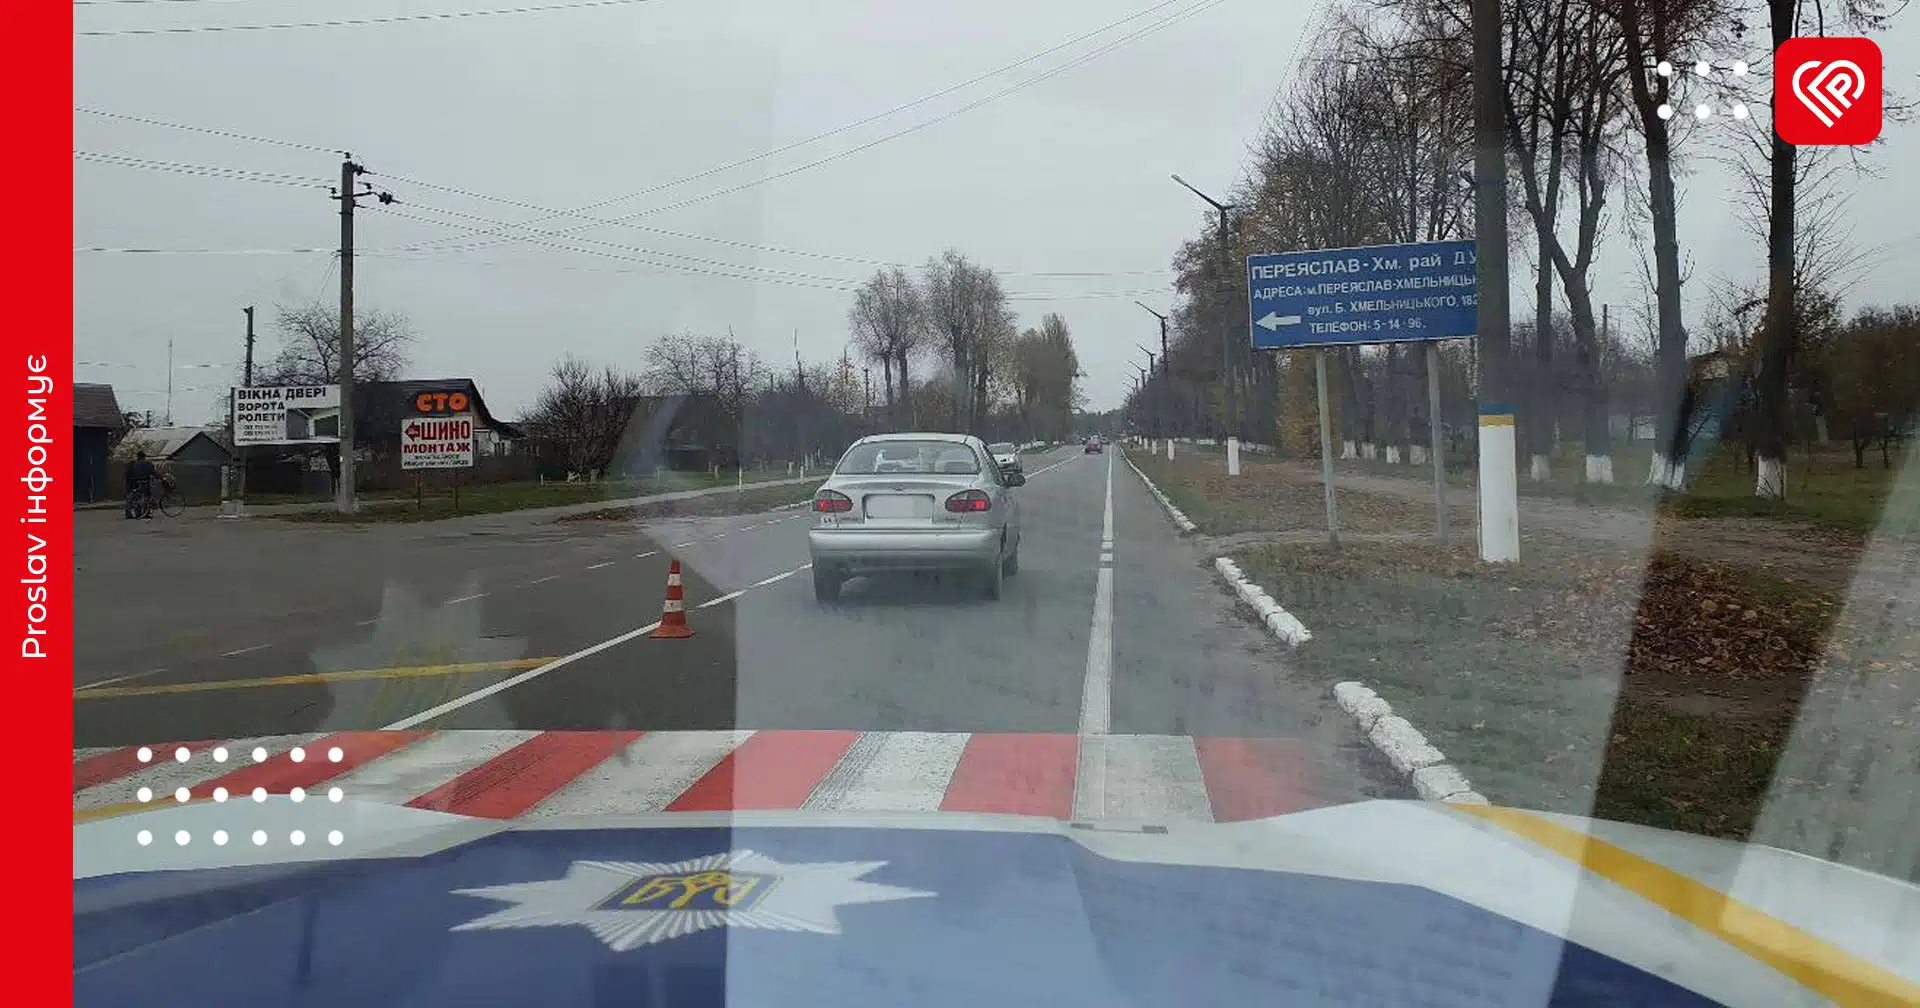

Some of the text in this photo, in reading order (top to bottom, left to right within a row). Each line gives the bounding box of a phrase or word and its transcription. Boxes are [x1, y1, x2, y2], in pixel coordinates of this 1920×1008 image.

[1409, 252, 1442, 272] рай
[1308, 305, 1333, 317] вул.
[1335, 302, 1347, 314] Б.
[238, 386, 326, 401] ВІКНА ДВЕРІ
[237, 400, 285, 412] ВОРОТА
[416, 392, 467, 411] СТО
[237, 411, 286, 422] РОЛЕТИ
[420, 420, 471, 441] ШИНО
[403, 442, 471, 454] МОНТАЖ
